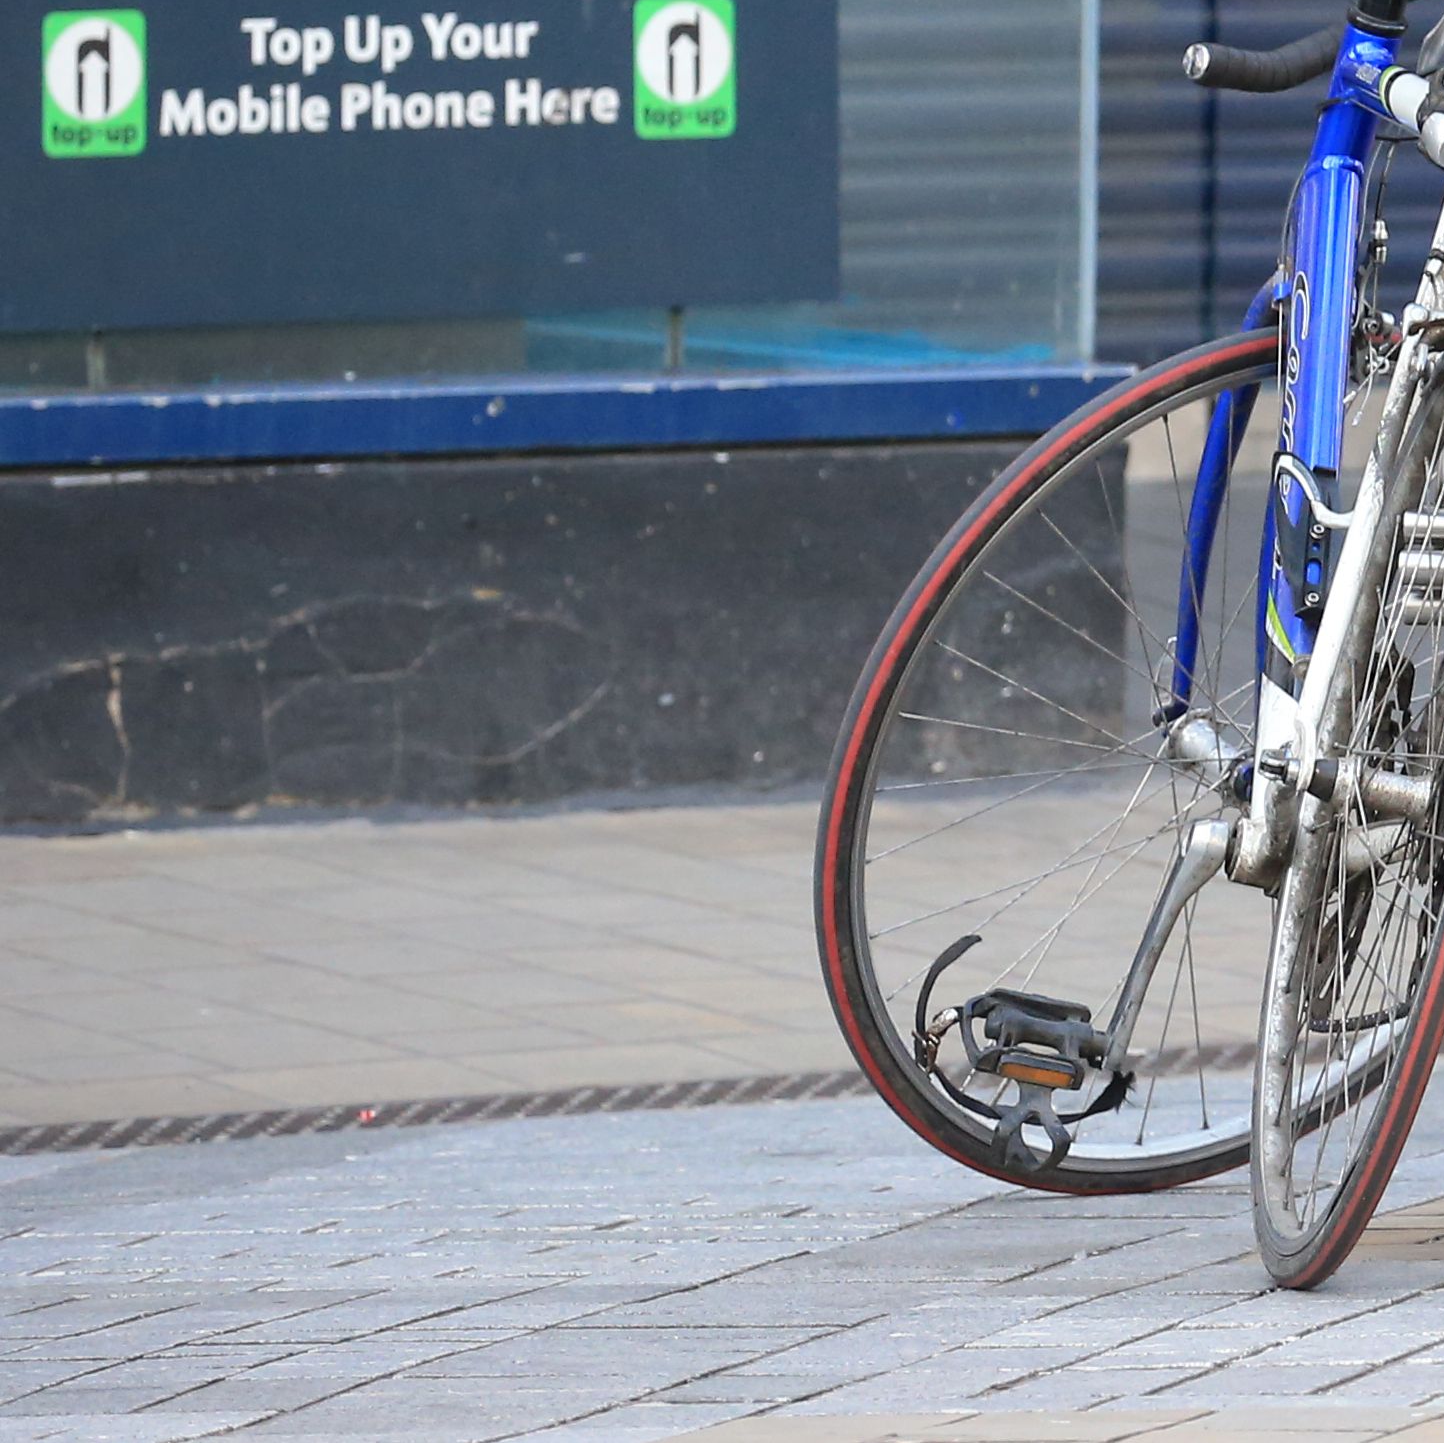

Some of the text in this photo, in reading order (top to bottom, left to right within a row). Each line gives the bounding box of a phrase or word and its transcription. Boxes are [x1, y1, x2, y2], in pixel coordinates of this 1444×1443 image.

[240, 12, 540, 76] Top Up Your
[158, 77, 622, 138] Mobile Phone Here
